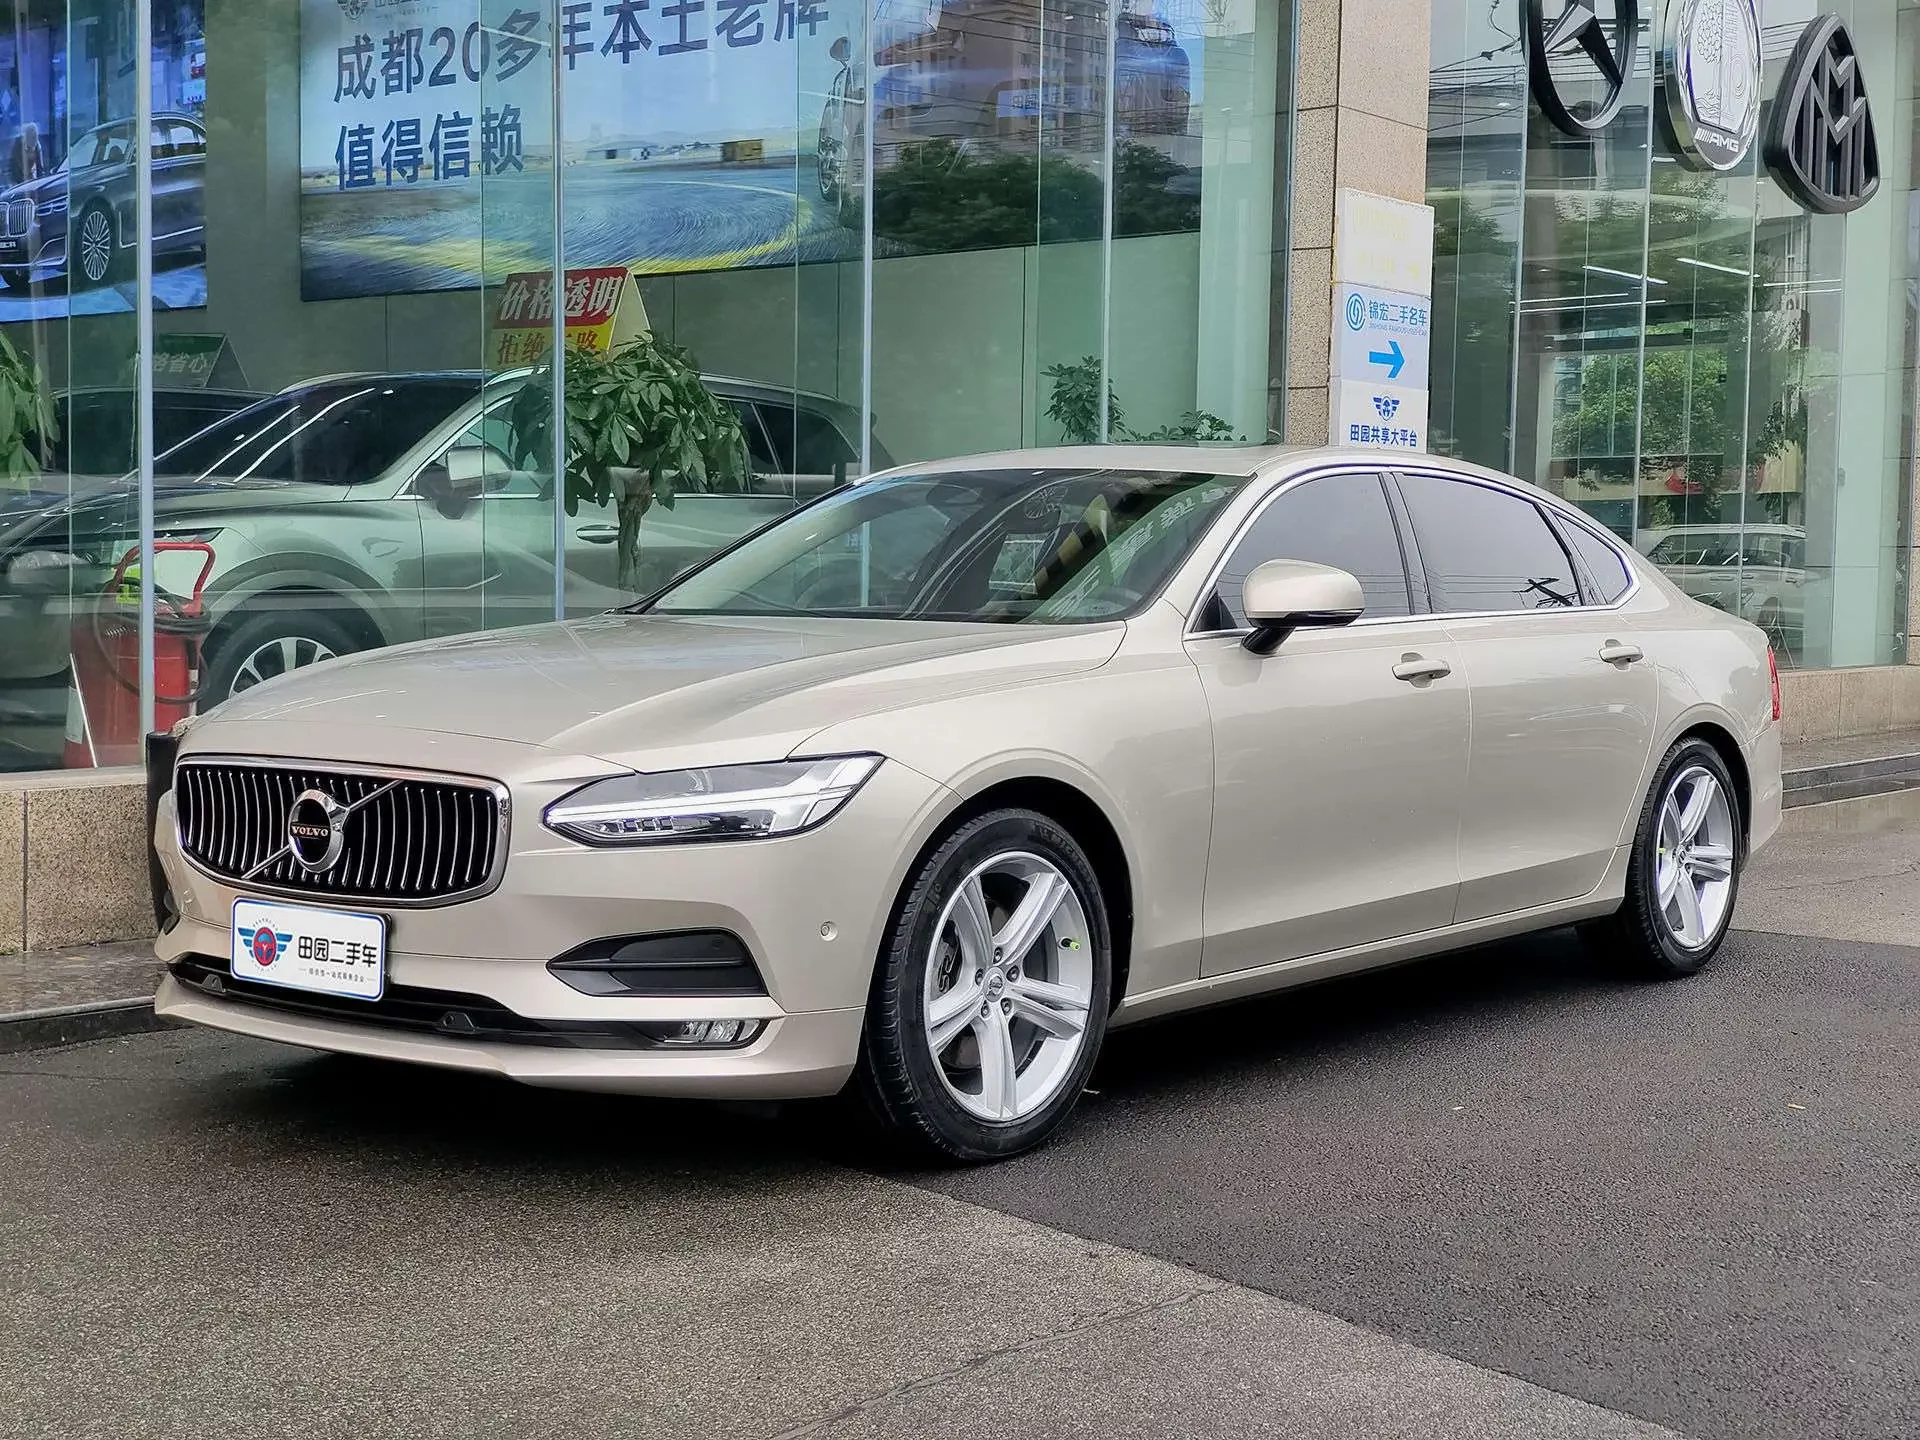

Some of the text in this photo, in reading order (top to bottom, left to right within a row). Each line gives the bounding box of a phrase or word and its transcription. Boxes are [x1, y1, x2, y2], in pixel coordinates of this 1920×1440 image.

[334, 104, 524, 191] 值得信赖
[1709, 131, 1740, 153] AMG
[1368, 300, 1427, 326] 锦宏二手名车
[1350, 424, 1418, 447] 田园共享大平台
[291, 825, 329, 837] VOLVO
[298, 935, 378, 968] 田园二手车
